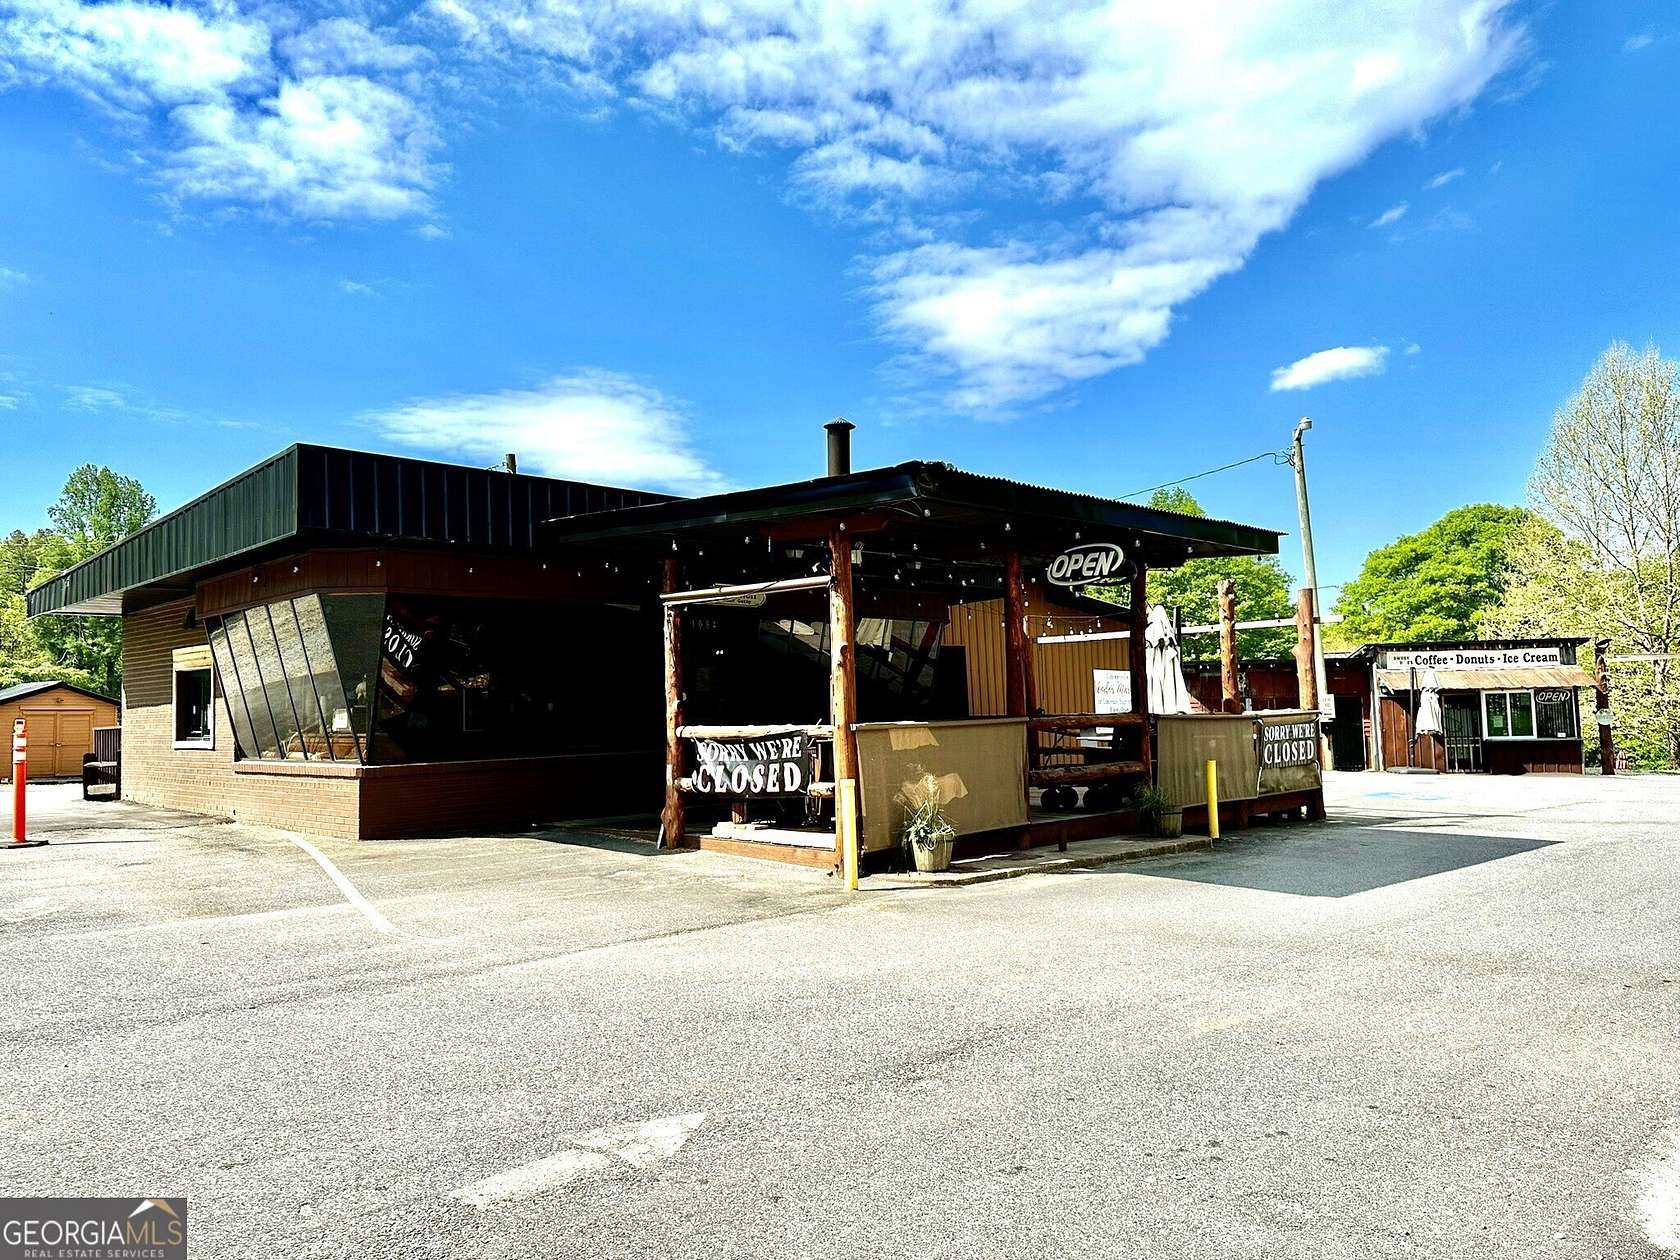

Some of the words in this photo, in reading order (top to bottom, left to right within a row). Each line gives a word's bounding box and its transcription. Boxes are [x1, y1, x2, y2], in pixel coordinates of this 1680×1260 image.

[1051, 550, 1115, 578] OPEN
[1414, 654, 1448, 666] Coffee
[1455, 654, 1495, 665] Donuts
[1502, 653, 1519, 664] Ice
[1523, 652, 1559, 663] Cream
[1538, 692, 1567, 702] OPEN
[1264, 725, 1290, 742] SORRY
[1291, 723, 1316, 739] WE'RE
[697, 741, 749, 762] SORRY
[749, 736, 802, 760] WE'RE
[1264, 740, 1315, 764] CLOSED
[697, 762, 802, 794] CLOSED
